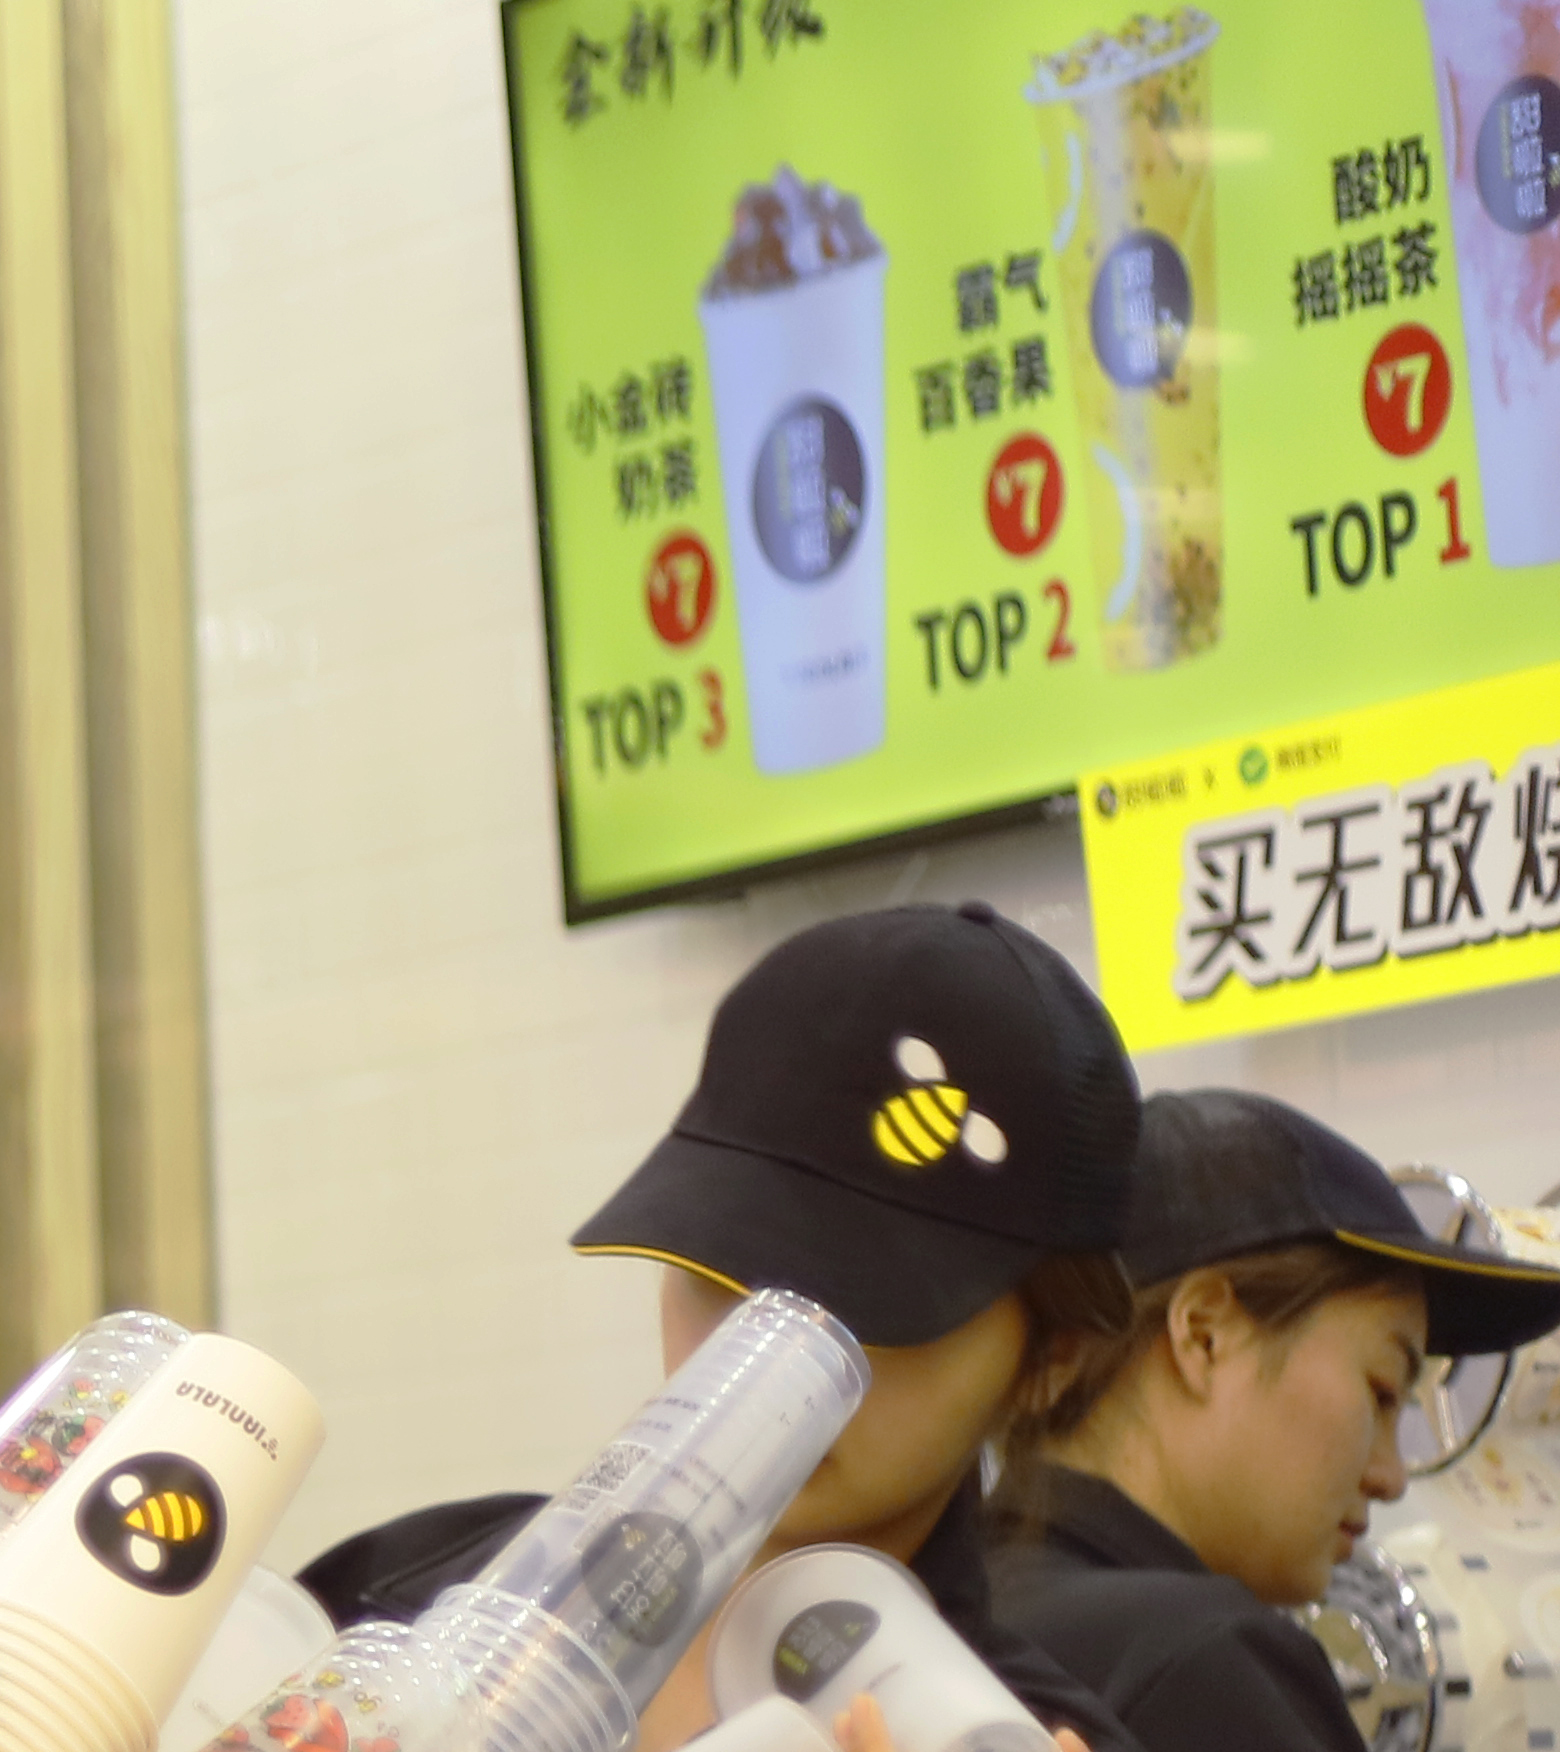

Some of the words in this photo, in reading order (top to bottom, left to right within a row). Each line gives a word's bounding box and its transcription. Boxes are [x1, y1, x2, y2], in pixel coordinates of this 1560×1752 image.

[1331, 134, 1432, 226] 酸奶
[1291, 221, 1439, 328] 摇摇茶
[1289, 488, 1418, 599] TOP
[1436, 476, 1471, 565] 1
[912, 589, 1026, 692] TOP
[1042, 578, 1077, 663] 2
[581, 678, 684, 777] TOP
[698, 666, 728, 752] 3
